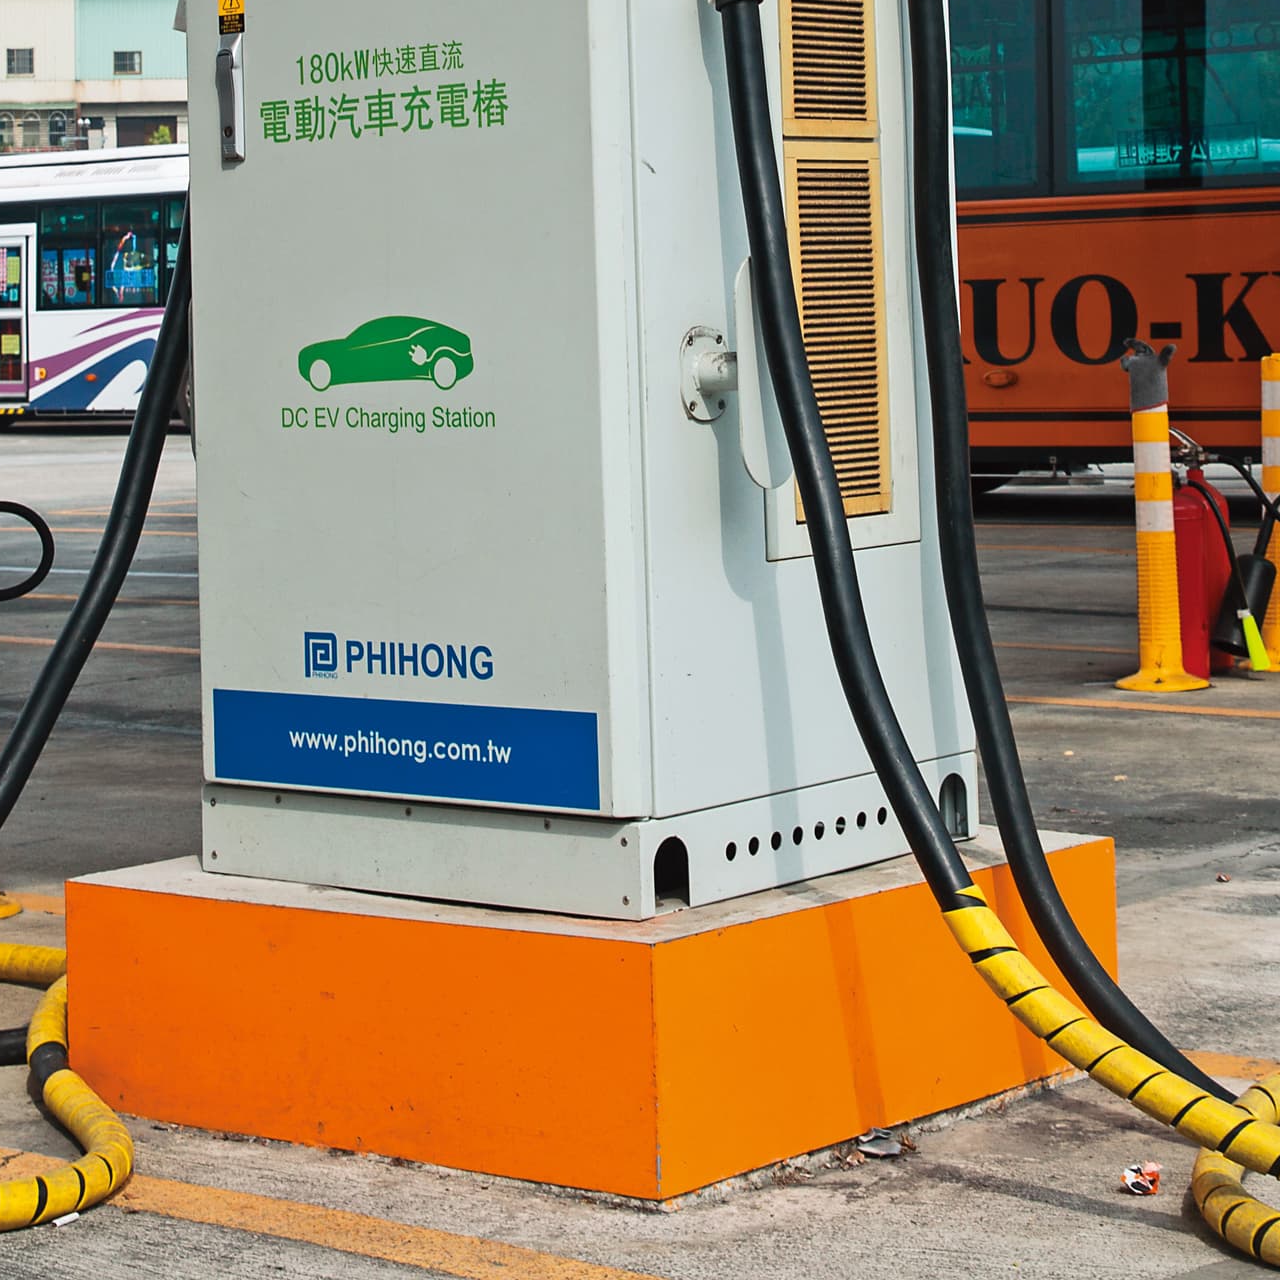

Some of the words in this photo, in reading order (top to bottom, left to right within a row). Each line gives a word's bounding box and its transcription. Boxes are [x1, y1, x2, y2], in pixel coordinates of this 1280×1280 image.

[296, 40, 465, 86] 180kW快速直流
[259, 78, 509, 144] 電動汽車充電樁
[281, 407, 309, 428] DC
[314, 407, 340, 428] EV
[345, 406, 426, 434] Charging
[431, 405, 496, 428] Station
[346, 640, 494, 681] PHIHONG
[289, 729, 512, 764] www.phihong.com.tw
